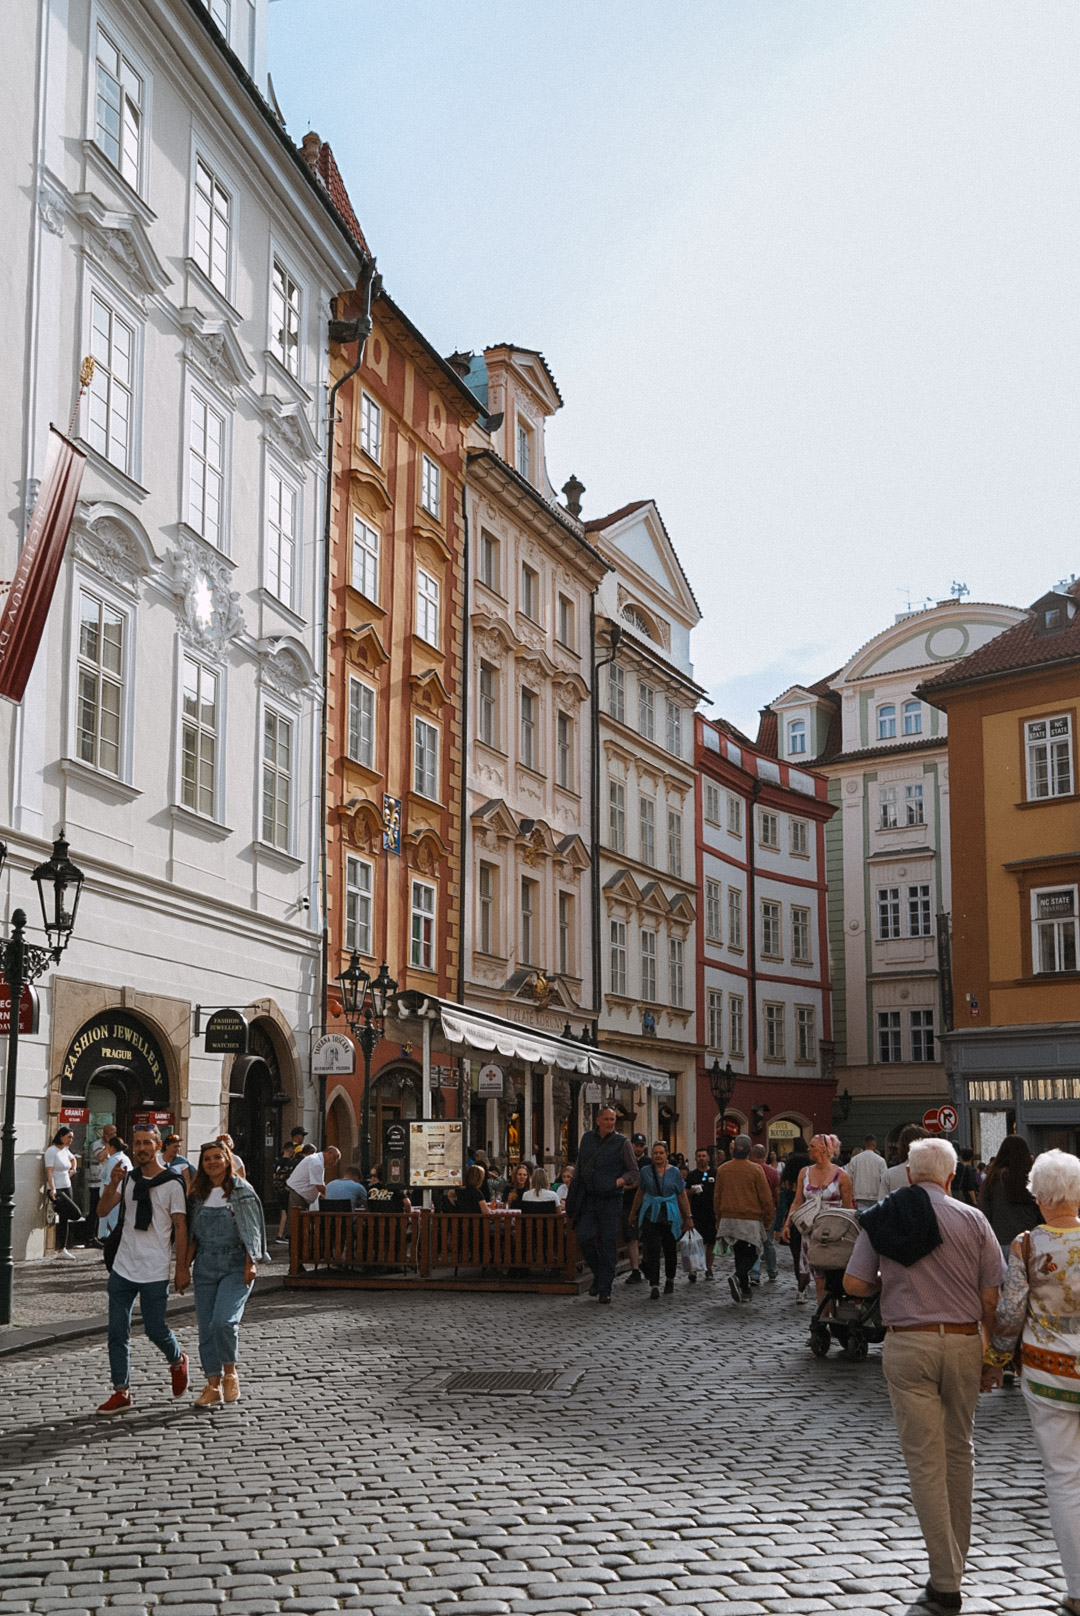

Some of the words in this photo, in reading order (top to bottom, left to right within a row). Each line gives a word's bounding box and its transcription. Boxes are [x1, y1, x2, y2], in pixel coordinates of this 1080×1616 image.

[1032, 724, 1042, 732] NC
[1054, 720, 1063, 728] NC
[1029, 731, 1045, 739] STATE
[1051, 727, 1068, 736] STATE
[1040, 898, 1050, 906] NC
[1050, 896, 1070, 905] STATE
[314, 1036, 331, 1055] TAVERNA
[332, 1035, 350, 1053] TOSCANA
[64, 1025, 109, 1080] FASHION
[113, 1025, 162, 1085] JEWELLERY
[102, 1048, 132, 1060] PRAGUE
[770, 1129, 794, 1137] BOUTIQUE
